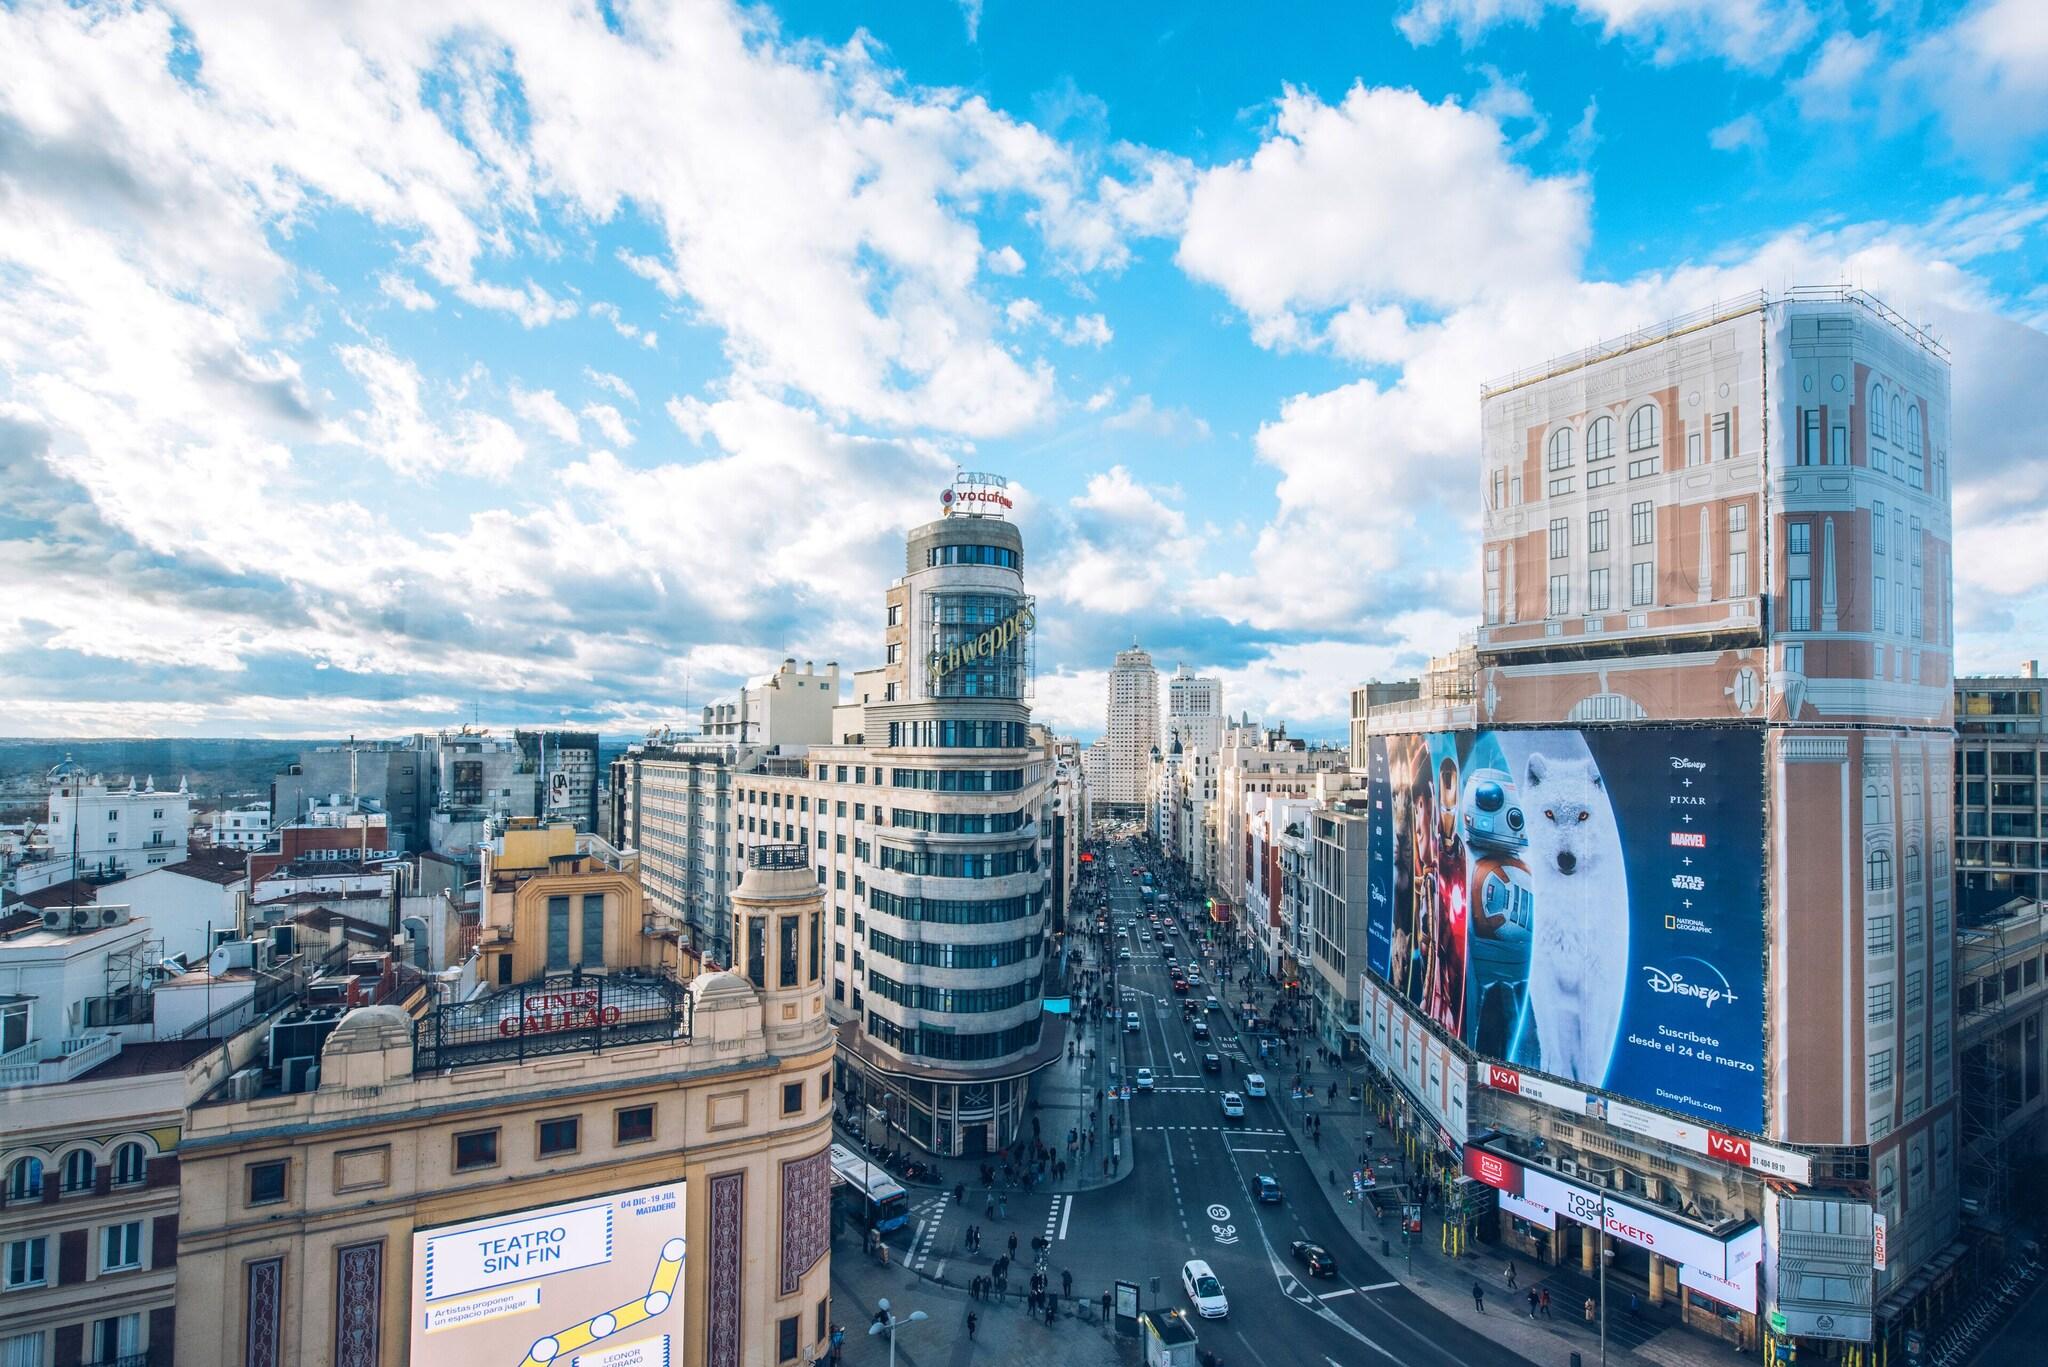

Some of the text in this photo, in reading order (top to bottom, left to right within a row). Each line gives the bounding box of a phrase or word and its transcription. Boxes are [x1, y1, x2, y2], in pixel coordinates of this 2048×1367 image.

[926, 602, 1036, 688] Schweppes
[1670, 757, 1707, 772] Disney
[1670, 796, 1706, 805] PIXAR
[1671, 833, 1705, 848] MARVEL
[1677, 918, 1704, 926] NATIONAL
[1677, 924, 1712, 934] GEOGRAPHIC
[525, 990, 599, 1012] CINES
[500, 1006, 620, 1036] CALLAO
[1658, 1025, 1719, 1047] Suscríbete
[1628, 1034, 1755, 1072] desde el 24 de marzo
[1656, 1088, 1722, 1113] DisneyPlus.com
[621, 1200, 631, 1209] 04
[632, 1197, 647, 1206] DIC
[651, 1194, 660, 1202] 19
[662, 1192, 676, 1201] JUL
[636, 1202, 676, 1216] MATADERO
[1568, 1203, 1594, 1221] LOS
[1601, 1216, 1654, 1245] ICKETS
[478, 1227, 566, 1257] TEATRO
[483, 1245, 560, 1273] SIN FIN
[434, 1300, 527, 1326] un espacio para jugar
[435, 1295, 514, 1318] Artistas proponen
[603, 1349, 640, 1364] LEONOR
